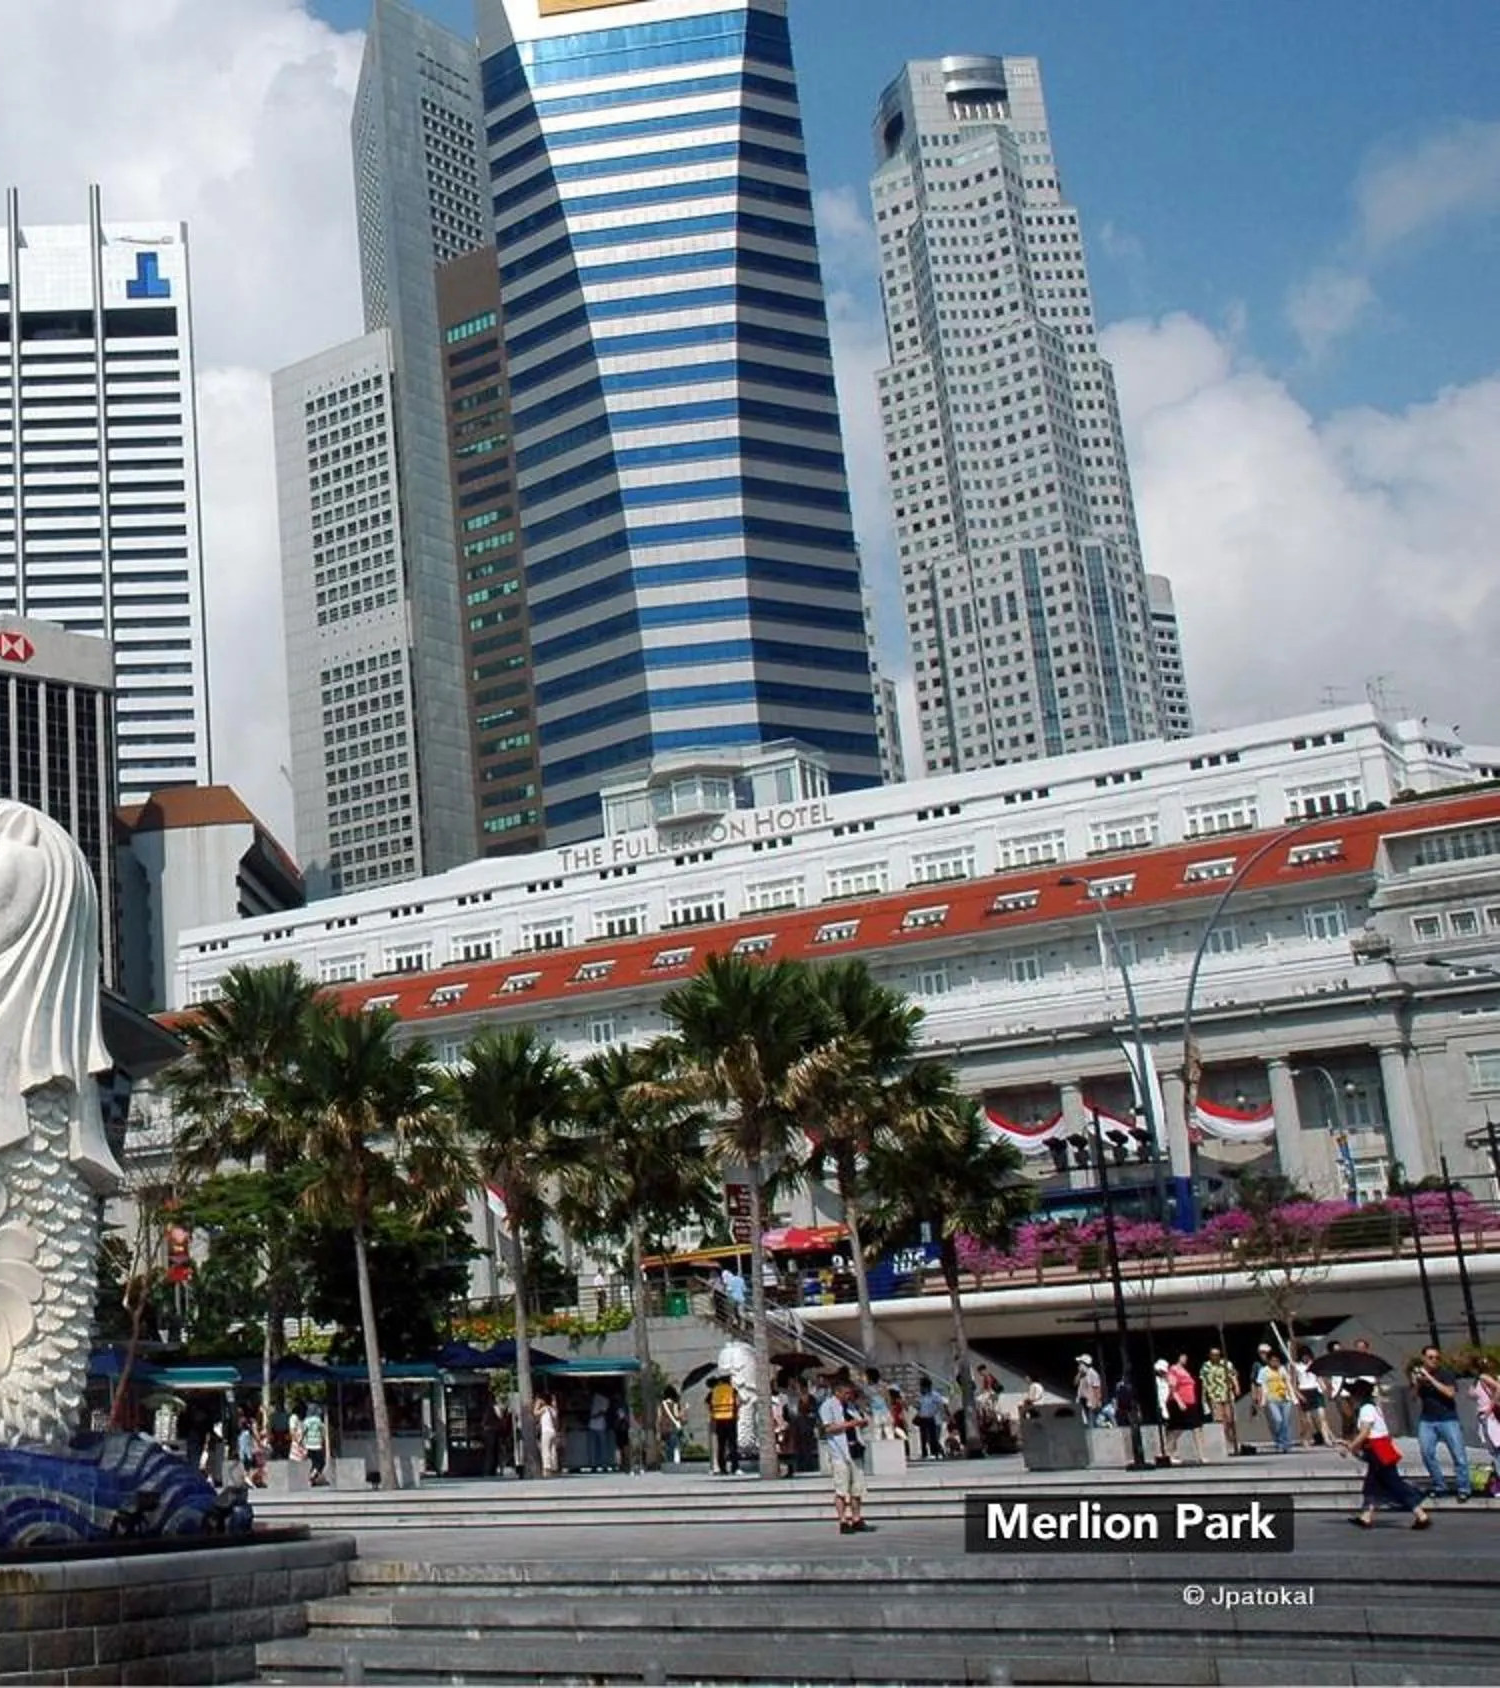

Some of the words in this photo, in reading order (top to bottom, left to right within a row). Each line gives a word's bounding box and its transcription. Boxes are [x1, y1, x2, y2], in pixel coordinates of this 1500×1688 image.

[557, 847, 603, 872] THE
[612, 818, 747, 864] FULLERTON
[755, 802, 834, 836] HOTEL
